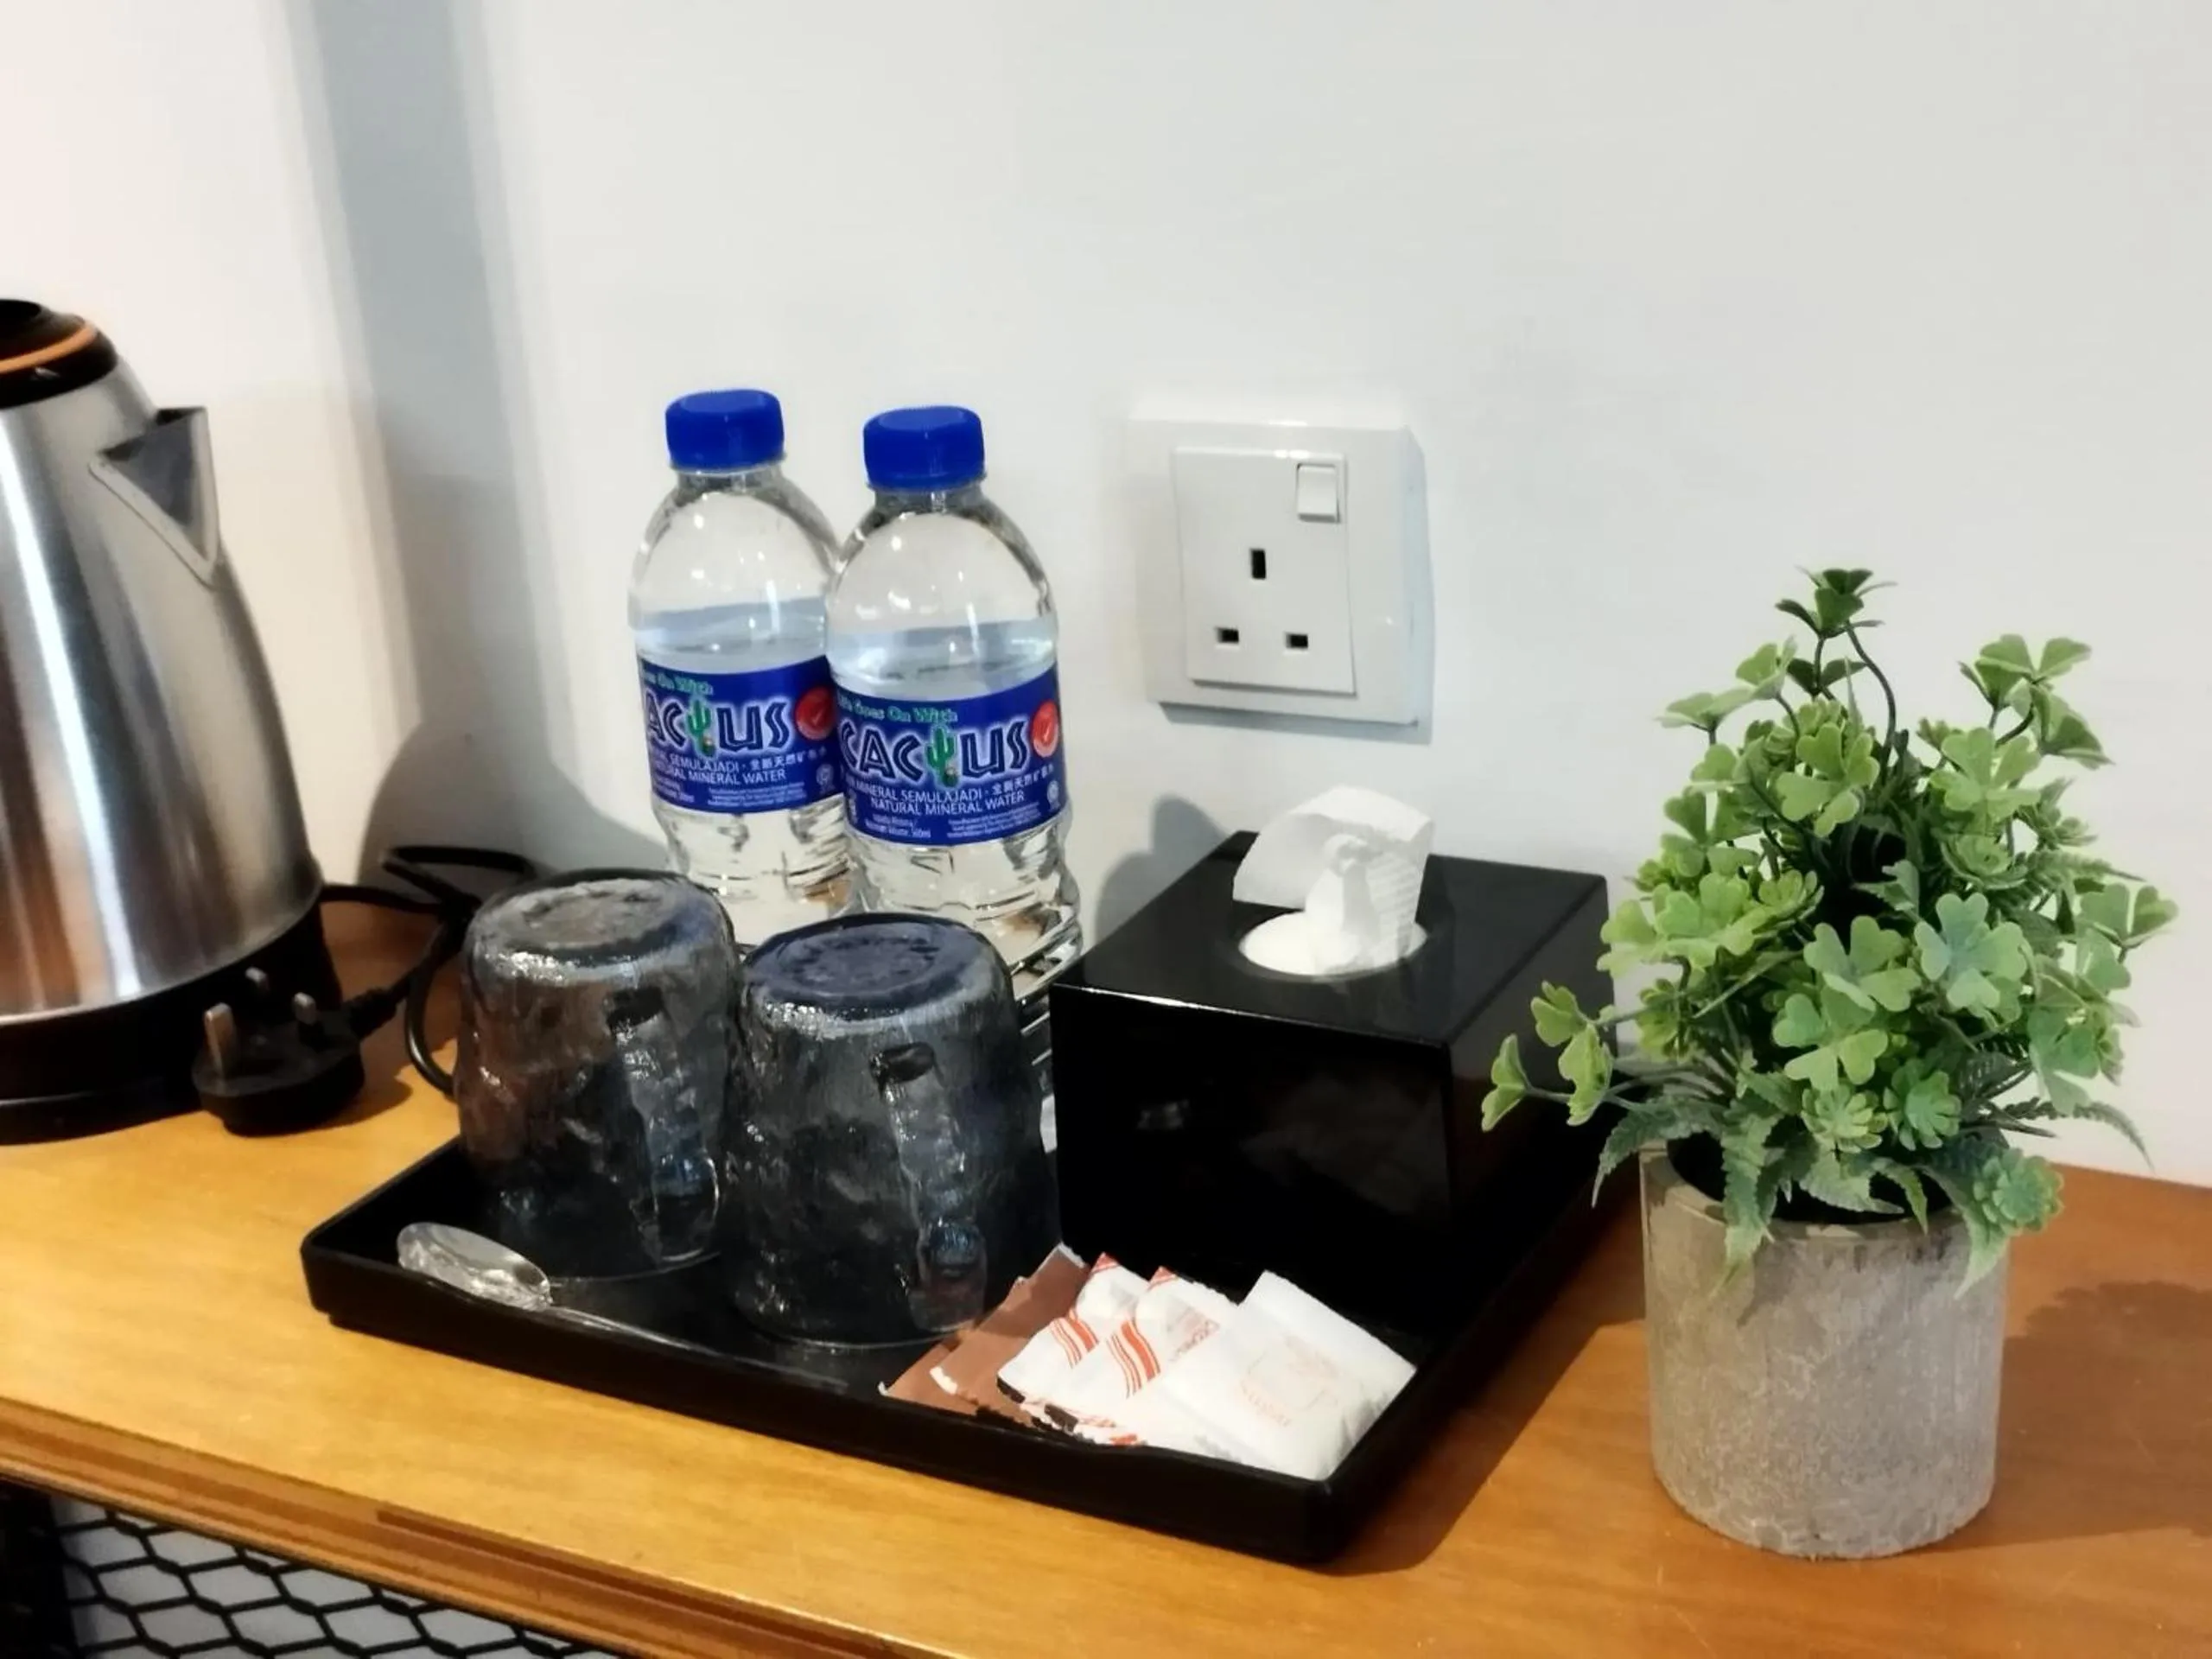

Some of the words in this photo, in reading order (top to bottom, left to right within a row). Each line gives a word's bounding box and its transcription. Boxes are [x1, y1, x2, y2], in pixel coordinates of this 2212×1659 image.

[645, 689, 793, 758] ACTUS
[887, 706, 912, 722] On
[912, 707, 958, 724] With
[669, 753, 739, 773] SEMULAJADI
[689, 771, 741, 785] MINERAL
[743, 769, 787, 785] WATER
[856, 780, 899, 801] MINERAL
[900, 789, 982, 804] SEMULAJADI
[870, 797, 922, 816] NATURAL
[925, 801, 983, 815] MINERAL
[985, 789, 1024, 810] WATER
